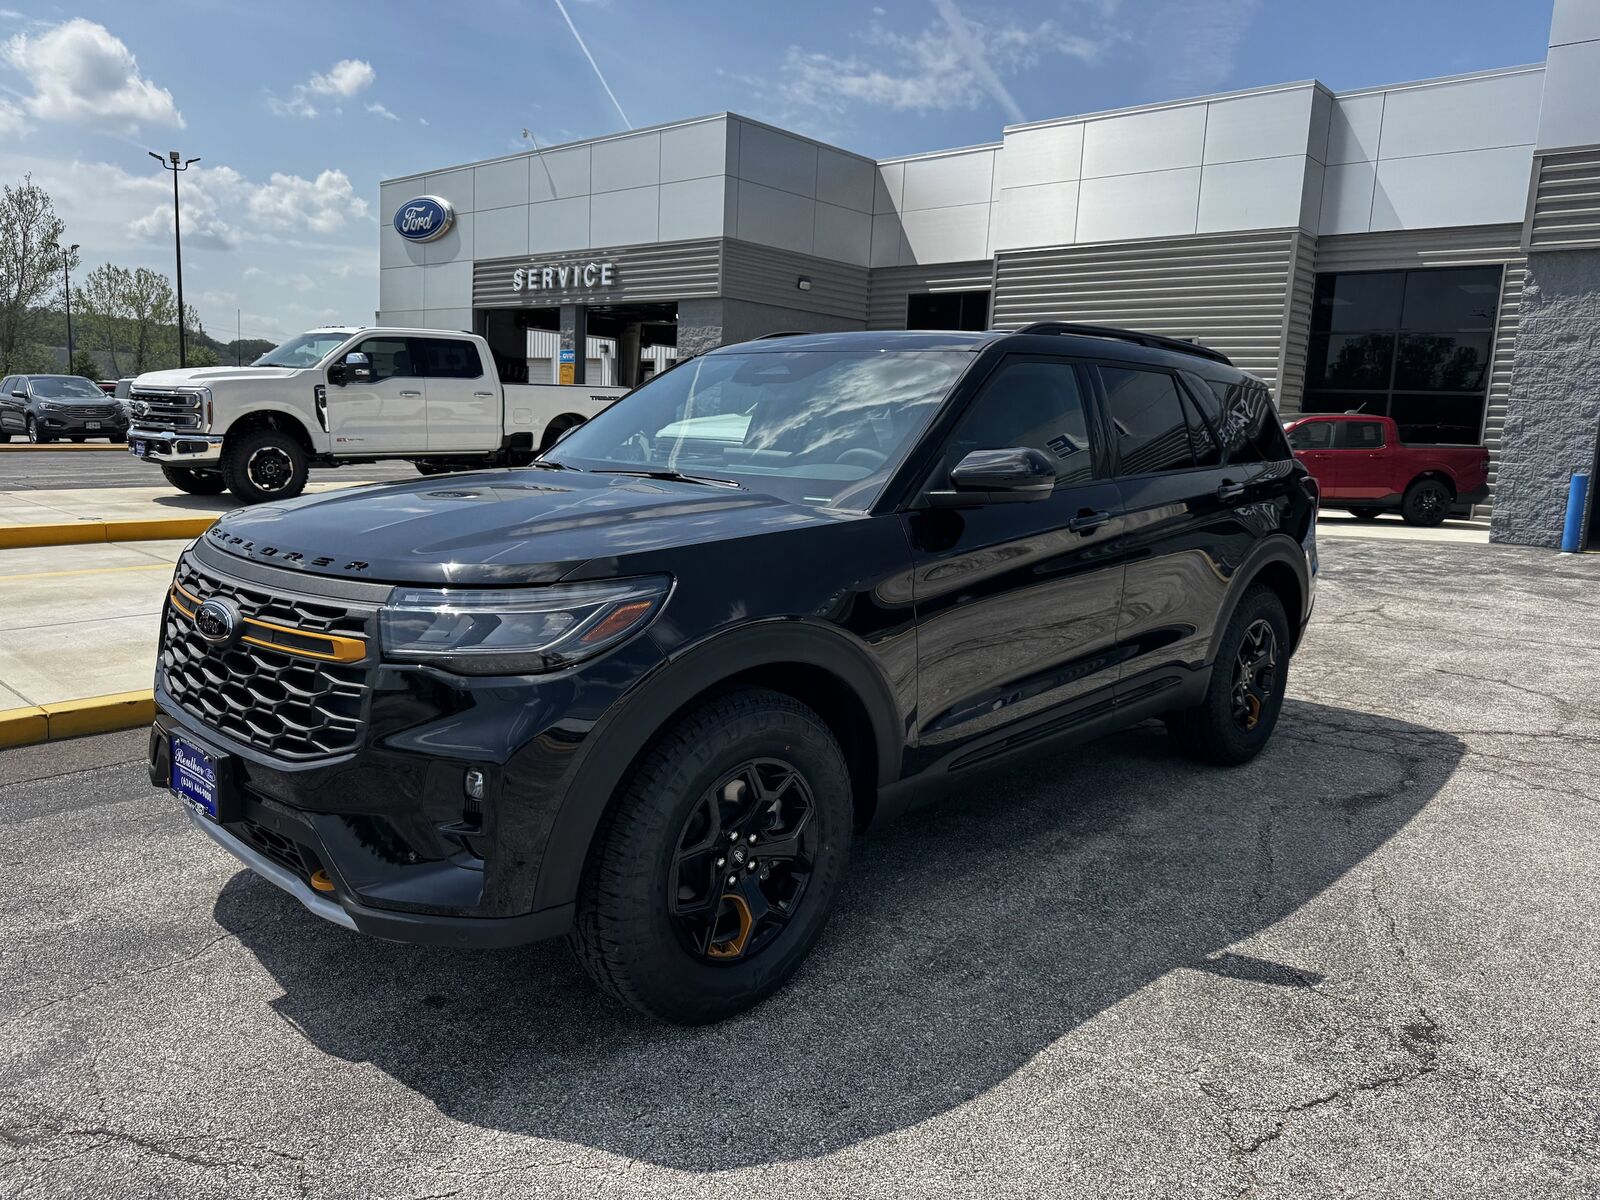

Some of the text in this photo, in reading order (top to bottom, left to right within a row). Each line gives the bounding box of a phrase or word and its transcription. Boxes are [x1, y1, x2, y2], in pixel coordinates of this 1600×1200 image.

[402, 206, 432, 232] Ford
[512, 262, 614, 291] SERVICE
[210, 527, 370, 571] EXPLORER
[198, 608, 221, 634] Ford
